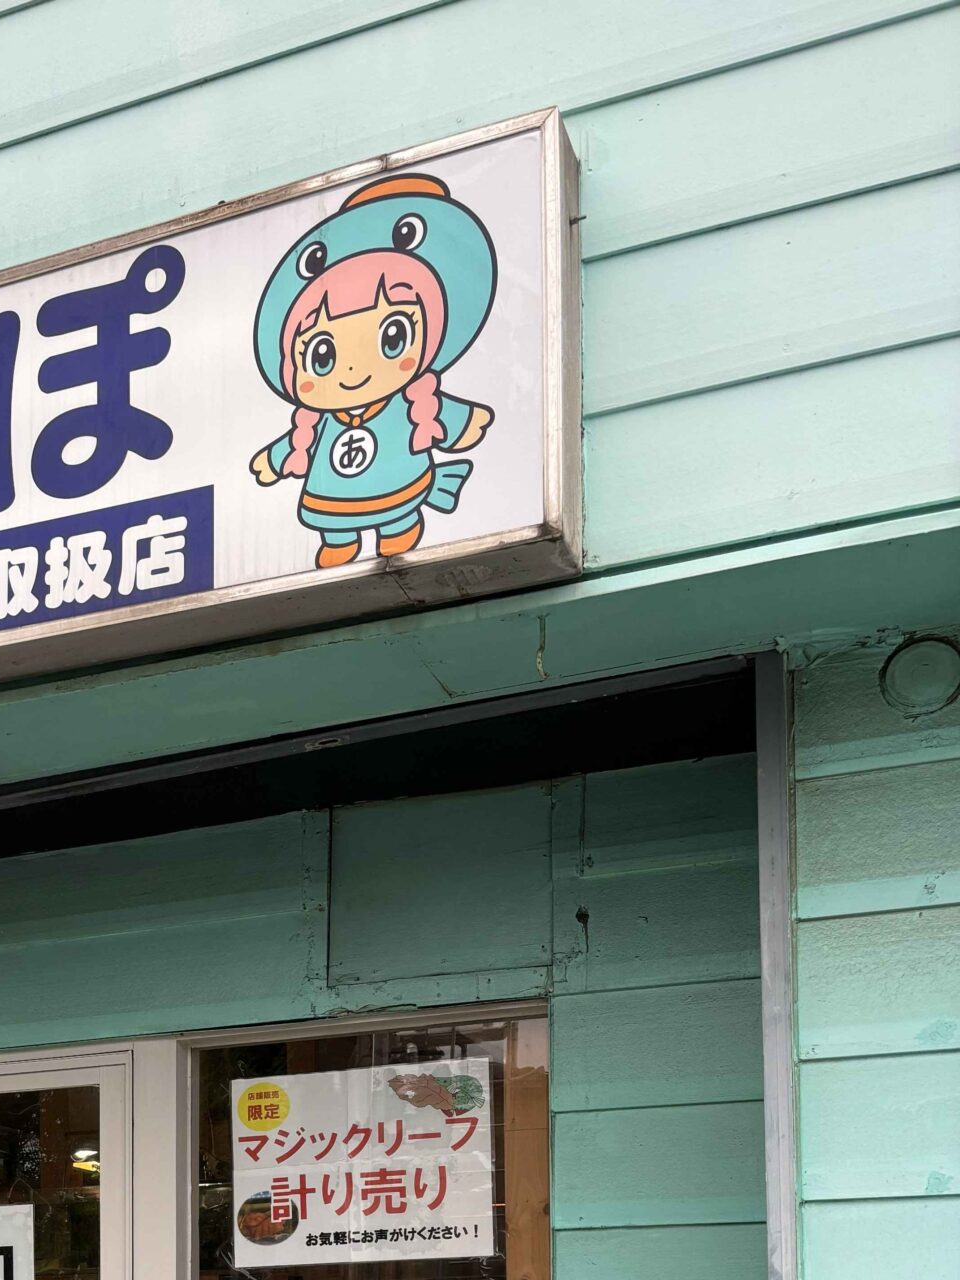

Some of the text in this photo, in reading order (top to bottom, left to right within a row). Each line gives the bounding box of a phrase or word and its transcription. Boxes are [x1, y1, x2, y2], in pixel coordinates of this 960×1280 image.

[340, 433, 370, 469] あ
[248, 1104, 280, 1121] 限定
[238, 1116, 479, 1164] マジックリーフ
[270, 1165, 448, 1223] 計り売り
